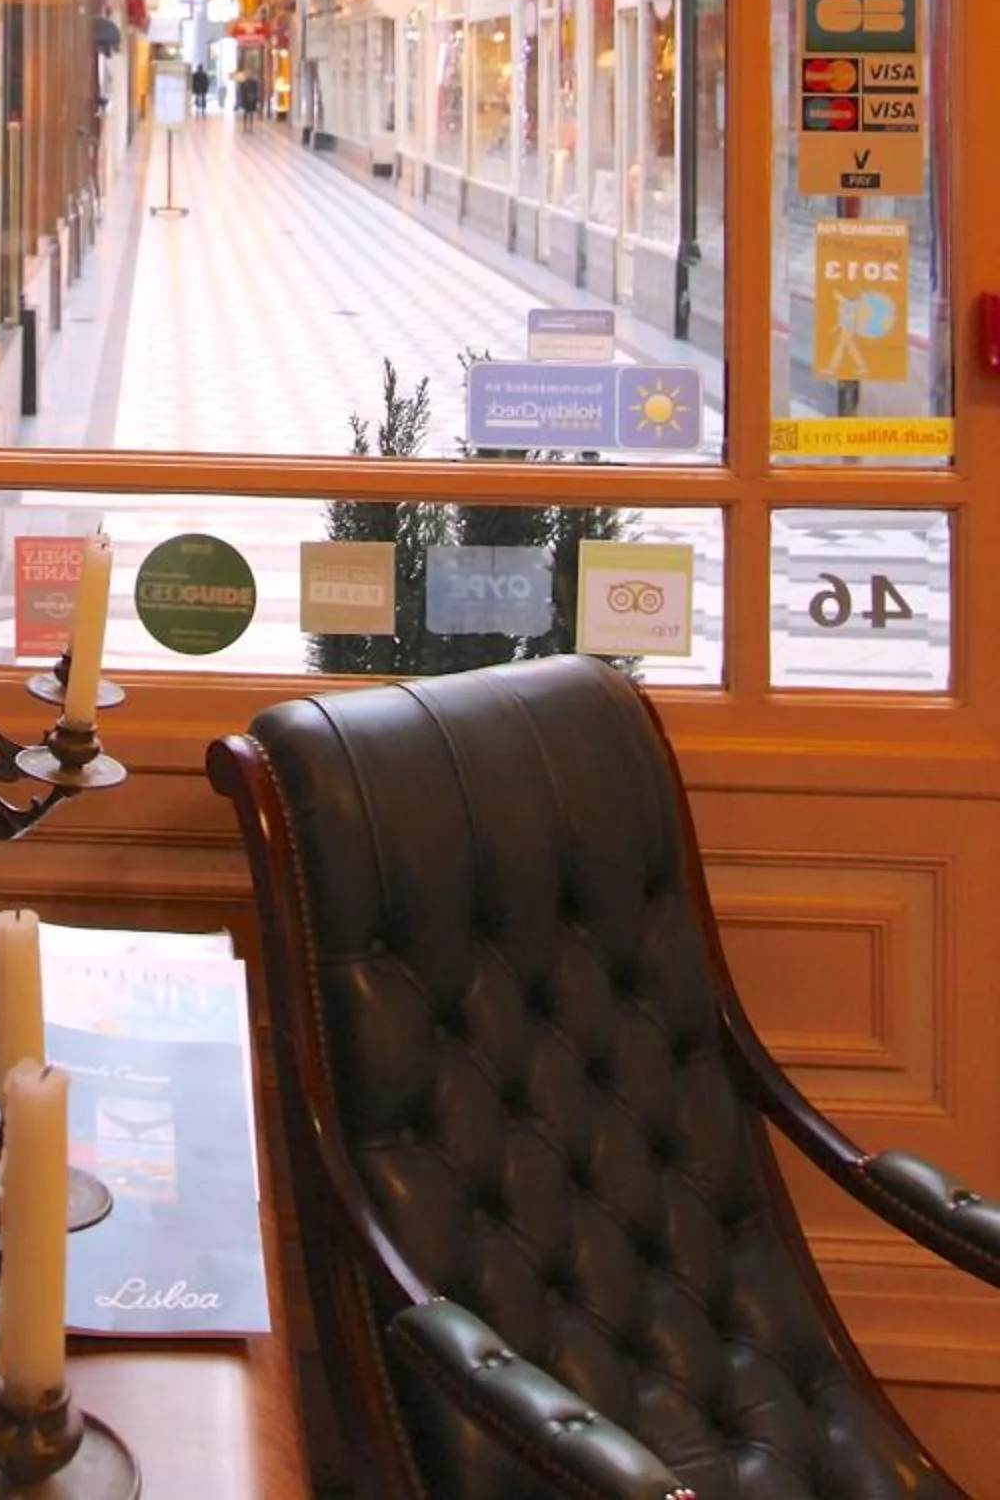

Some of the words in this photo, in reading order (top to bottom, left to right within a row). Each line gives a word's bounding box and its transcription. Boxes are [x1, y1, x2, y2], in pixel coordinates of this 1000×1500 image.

[869, 63, 916, 81] VISA
[869, 101, 916, 119] VISA
[847, 175, 874, 187] PAY
[95, 1276, 222, 1311] Lisboa
